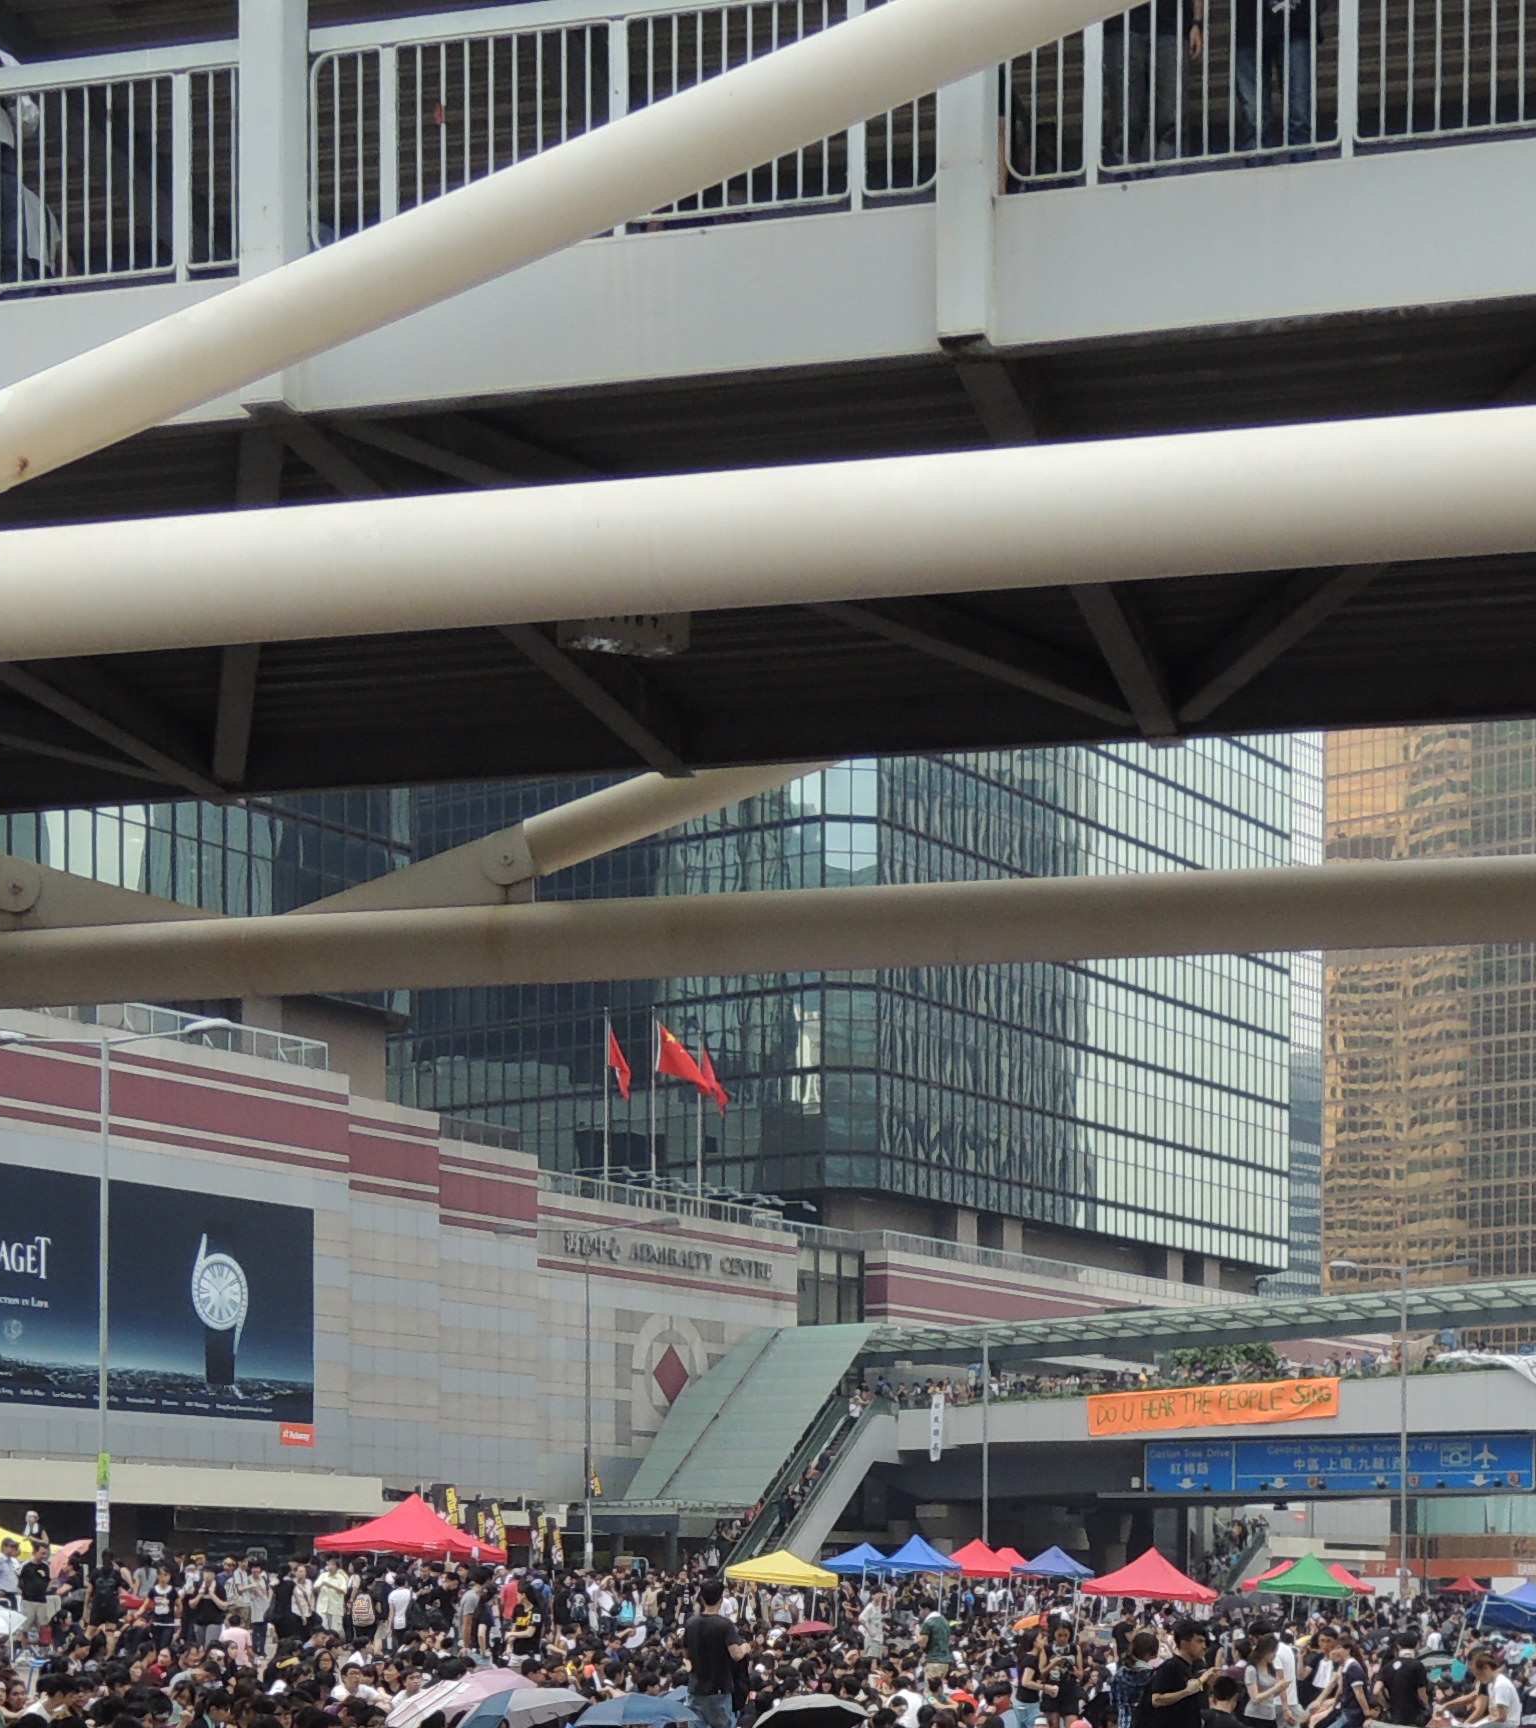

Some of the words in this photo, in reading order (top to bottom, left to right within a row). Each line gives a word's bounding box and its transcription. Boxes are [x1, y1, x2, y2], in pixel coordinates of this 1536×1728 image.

[629, 1241, 713, 1271] ADMIRALTY
[719, 1255, 773, 1280] CENTRE
[1096, 1405, 1116, 1426] DO
[1121, 1402, 1135, 1423] U
[1140, 1396, 1176, 1421] HEAR
[1180, 1390, 1214, 1415] THE
[1218, 1386, 1286, 1413] PEOPLE
[1289, 1384, 1332, 1406] SING
[1149, 1449, 1182, 1459] Cotton
[1184, 1448, 1204, 1458] Tree
[1206, 1448, 1231, 1458] Drive
